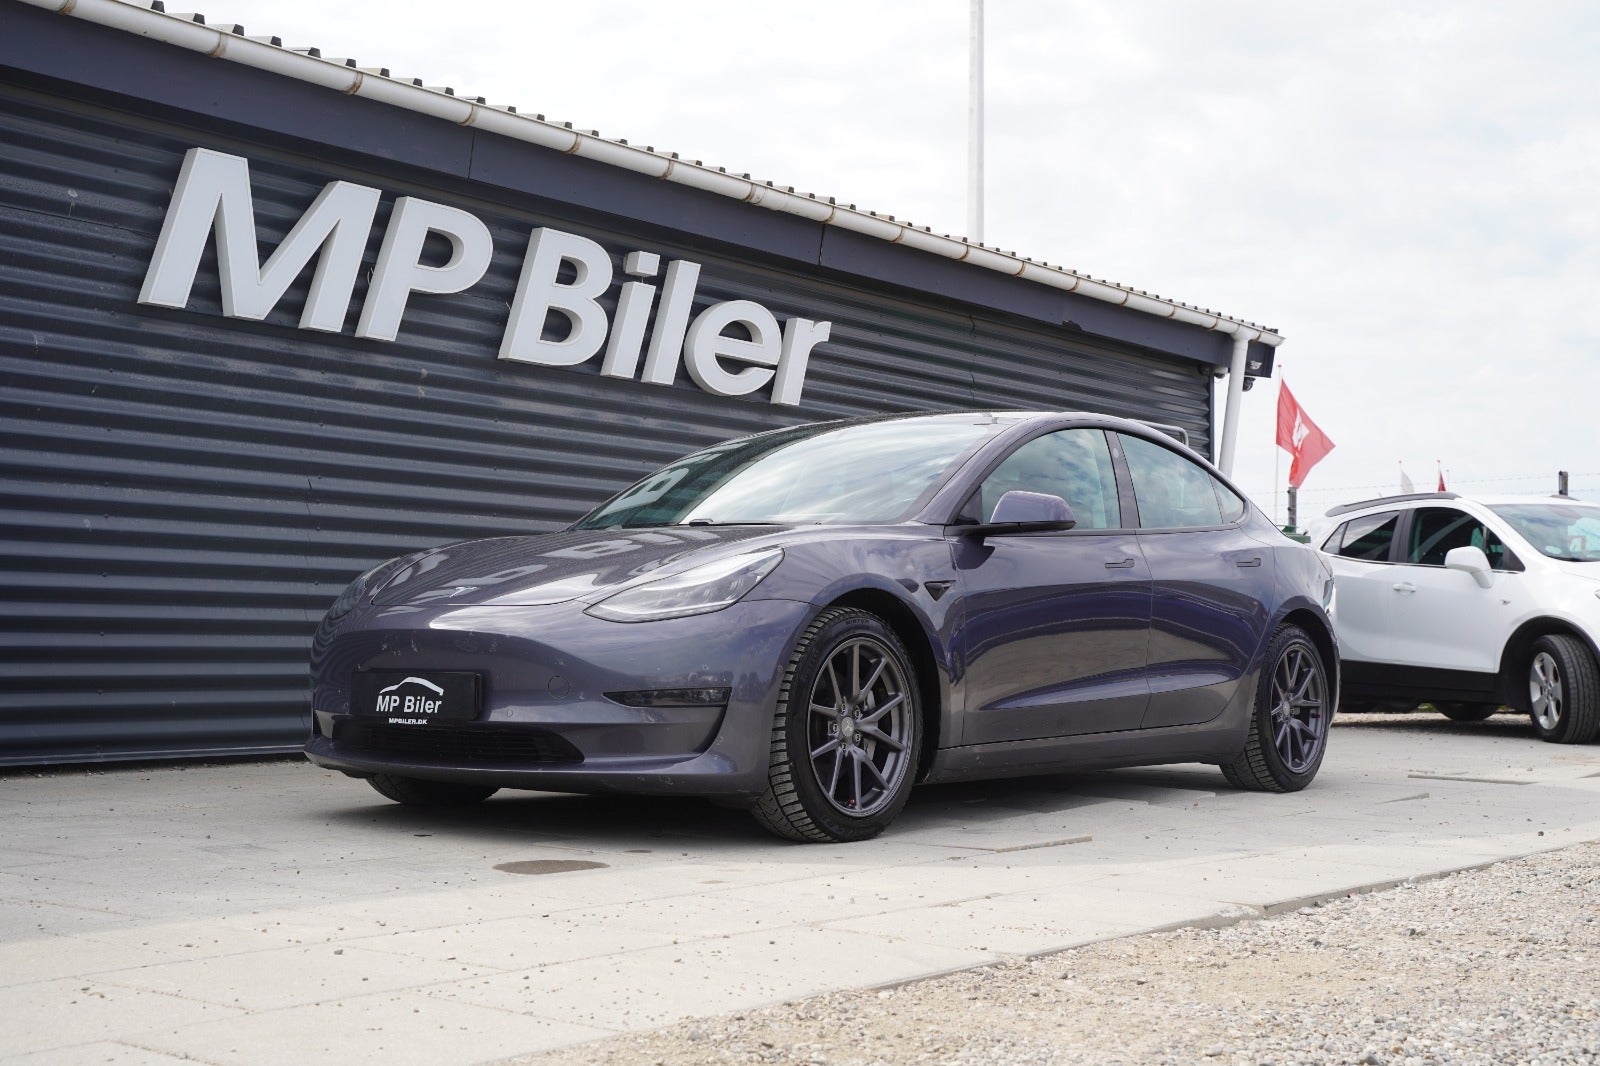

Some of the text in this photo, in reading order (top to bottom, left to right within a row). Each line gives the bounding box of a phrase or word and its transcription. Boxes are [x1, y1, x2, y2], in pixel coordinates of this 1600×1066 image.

[137, 147, 831, 406] MP Biler
[376, 695, 442, 714] MP Biler
[388, 717, 428, 725] MPBILER.DK
